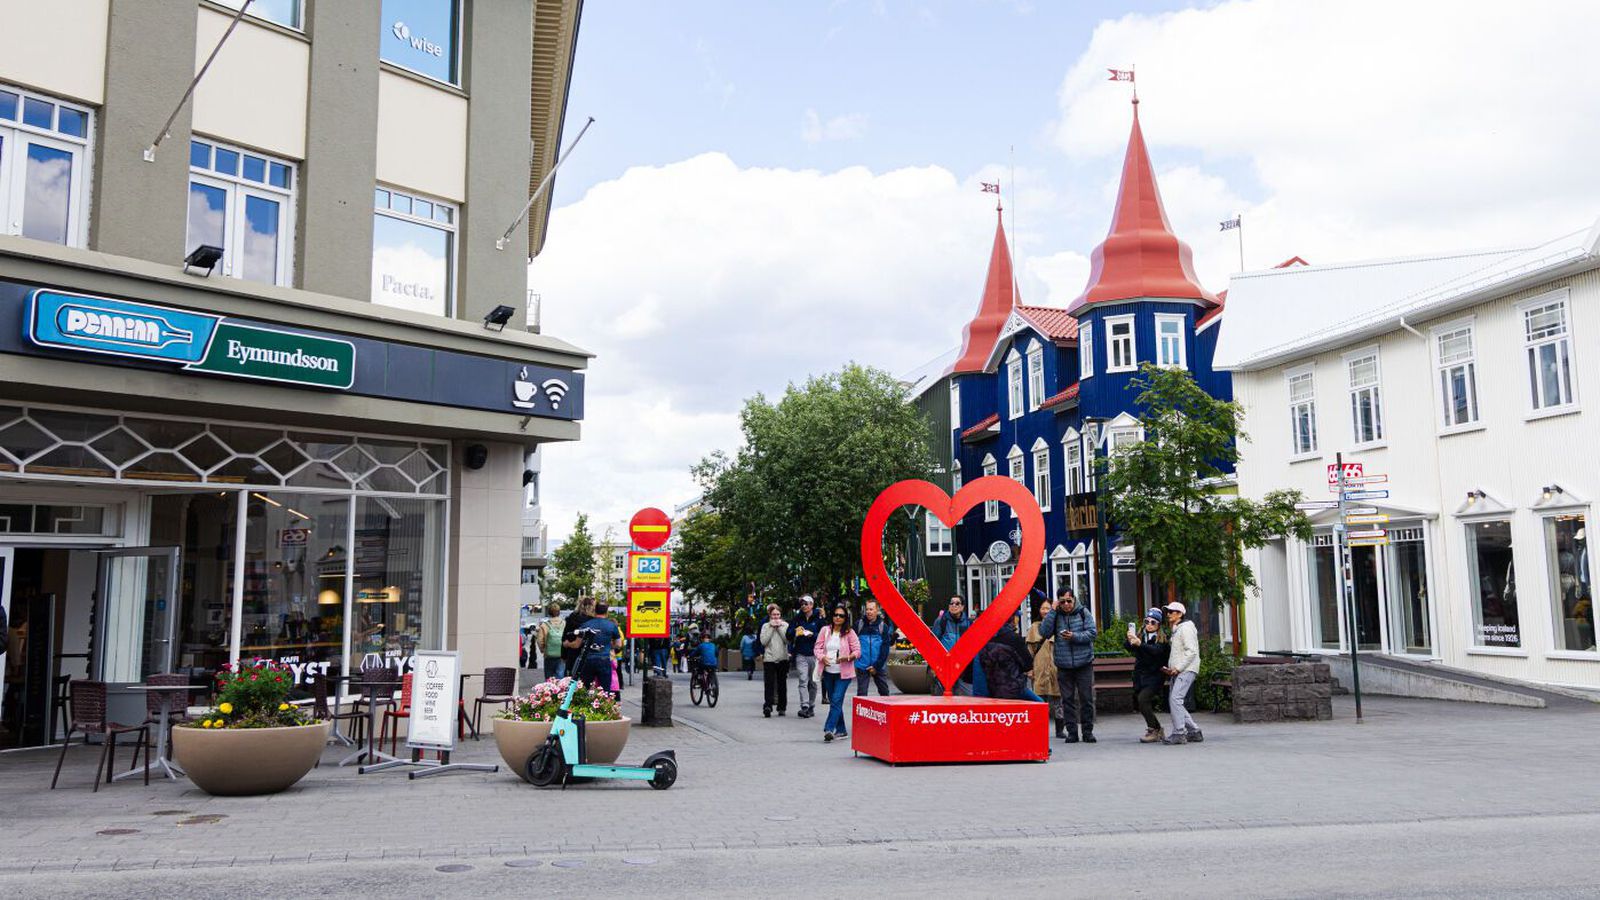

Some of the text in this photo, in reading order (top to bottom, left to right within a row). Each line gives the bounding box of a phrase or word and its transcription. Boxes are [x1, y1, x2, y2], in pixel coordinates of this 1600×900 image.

[409, 36, 442, 57] wise
[382, 274, 434, 300] Pacta.
[226, 339, 339, 372] Eymundsson
[1343, 464, 1362, 479] 66
[639, 559, 649, 572] P
[291, 662, 331, 684] YST
[426, 682, 444, 690] COFFEE
[909, 710, 1031, 727] #loveakureyri
